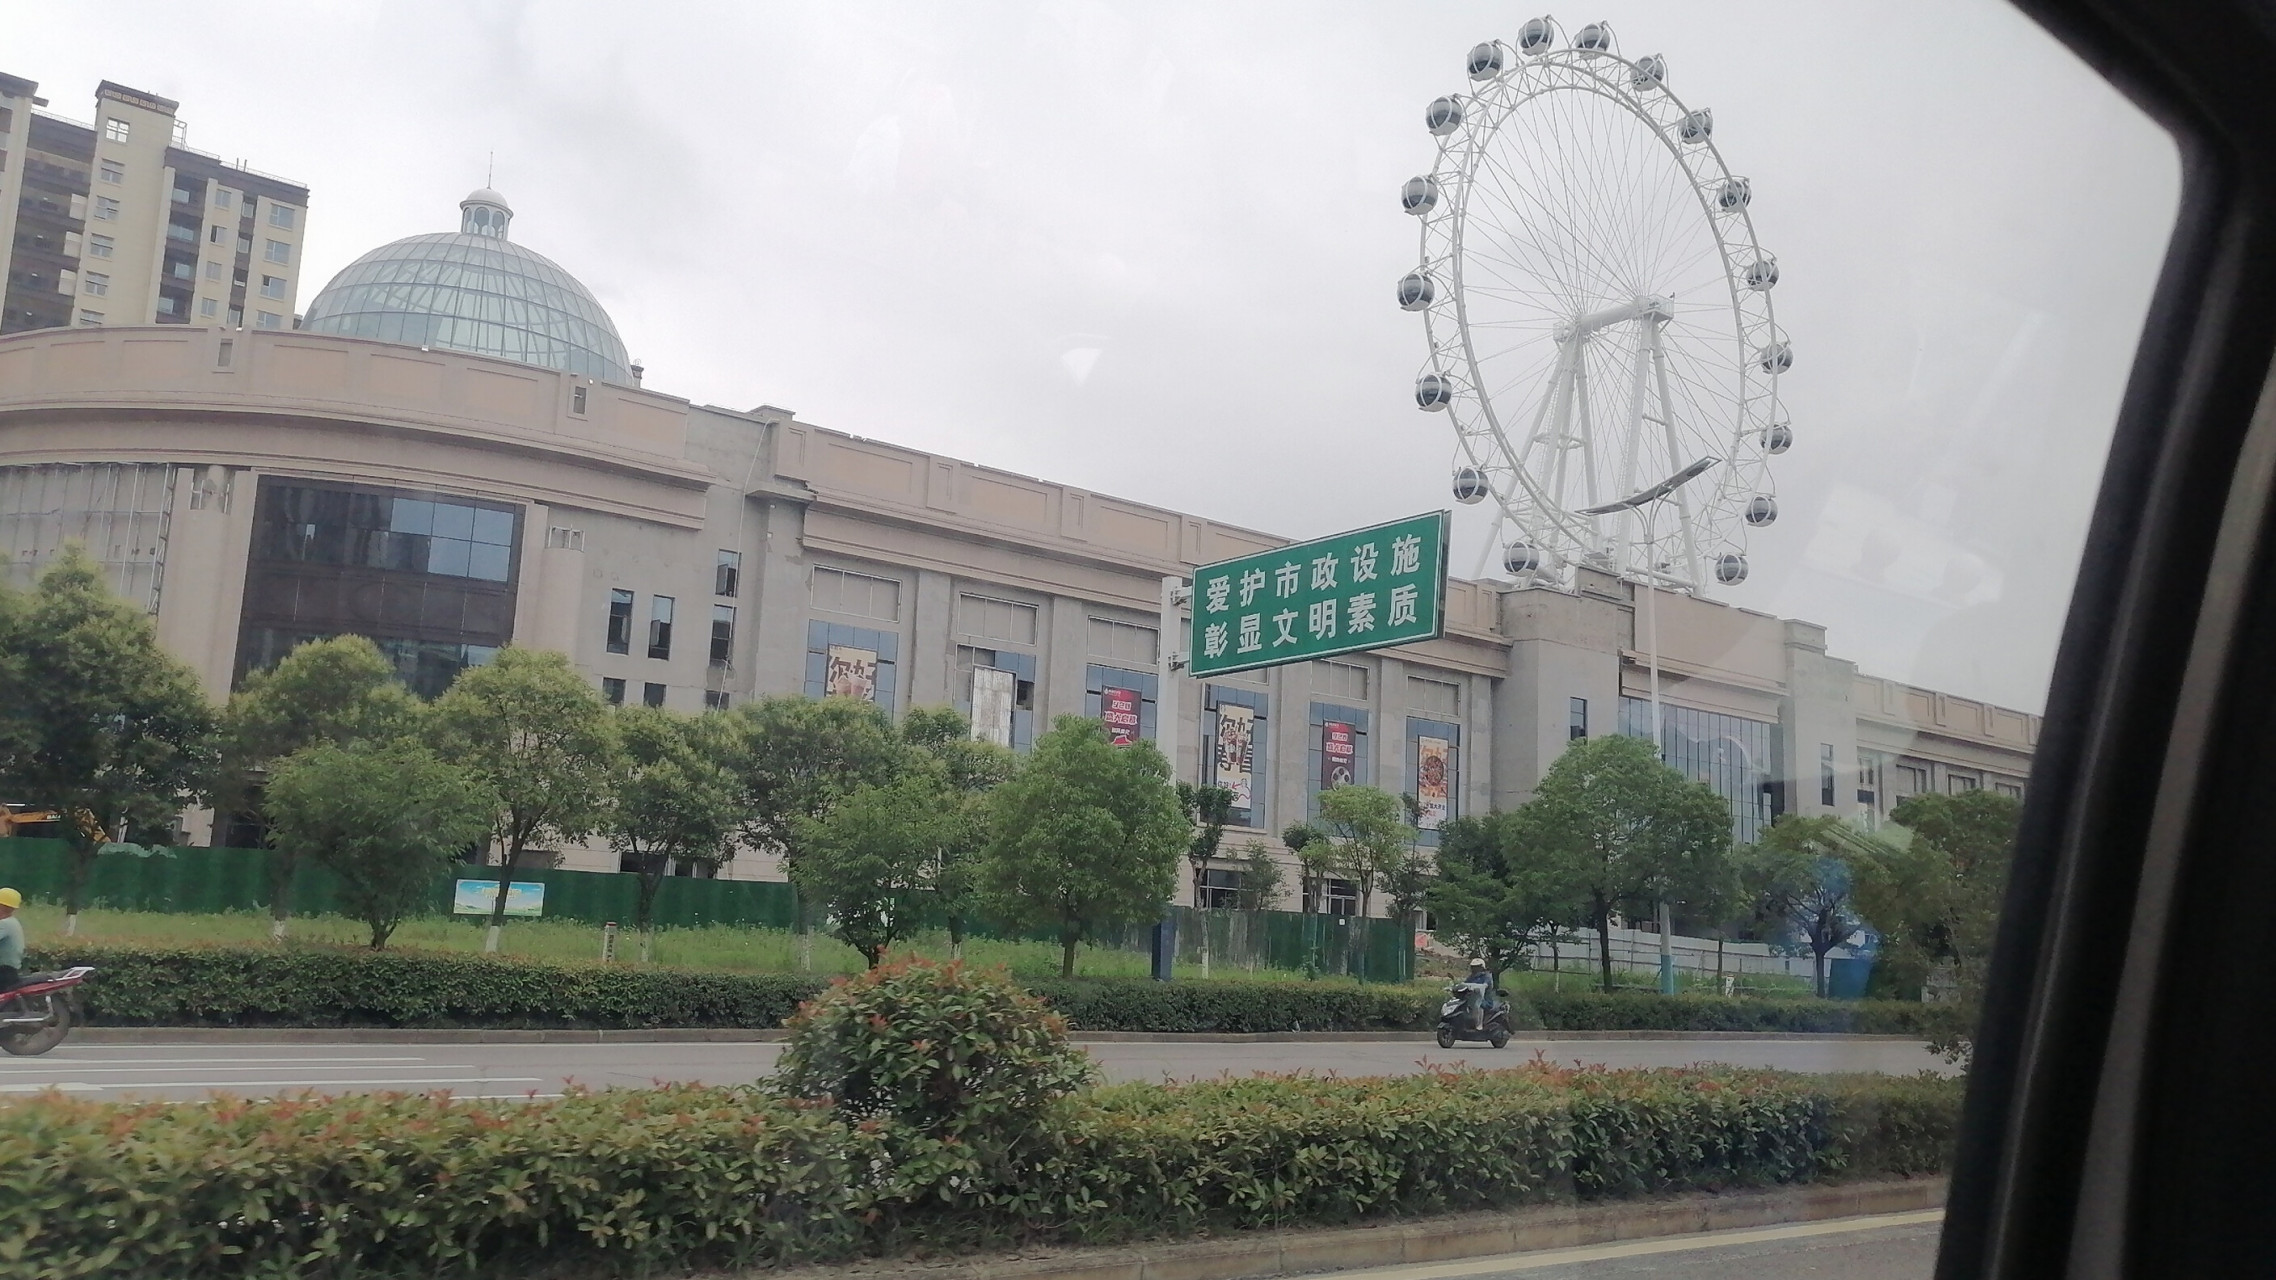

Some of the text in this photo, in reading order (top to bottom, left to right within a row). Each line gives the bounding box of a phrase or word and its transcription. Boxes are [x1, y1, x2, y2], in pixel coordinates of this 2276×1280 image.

[1205, 533, 1421, 614] 爱护市政设施
[1203, 583, 1419, 659] 彰显文明素质
